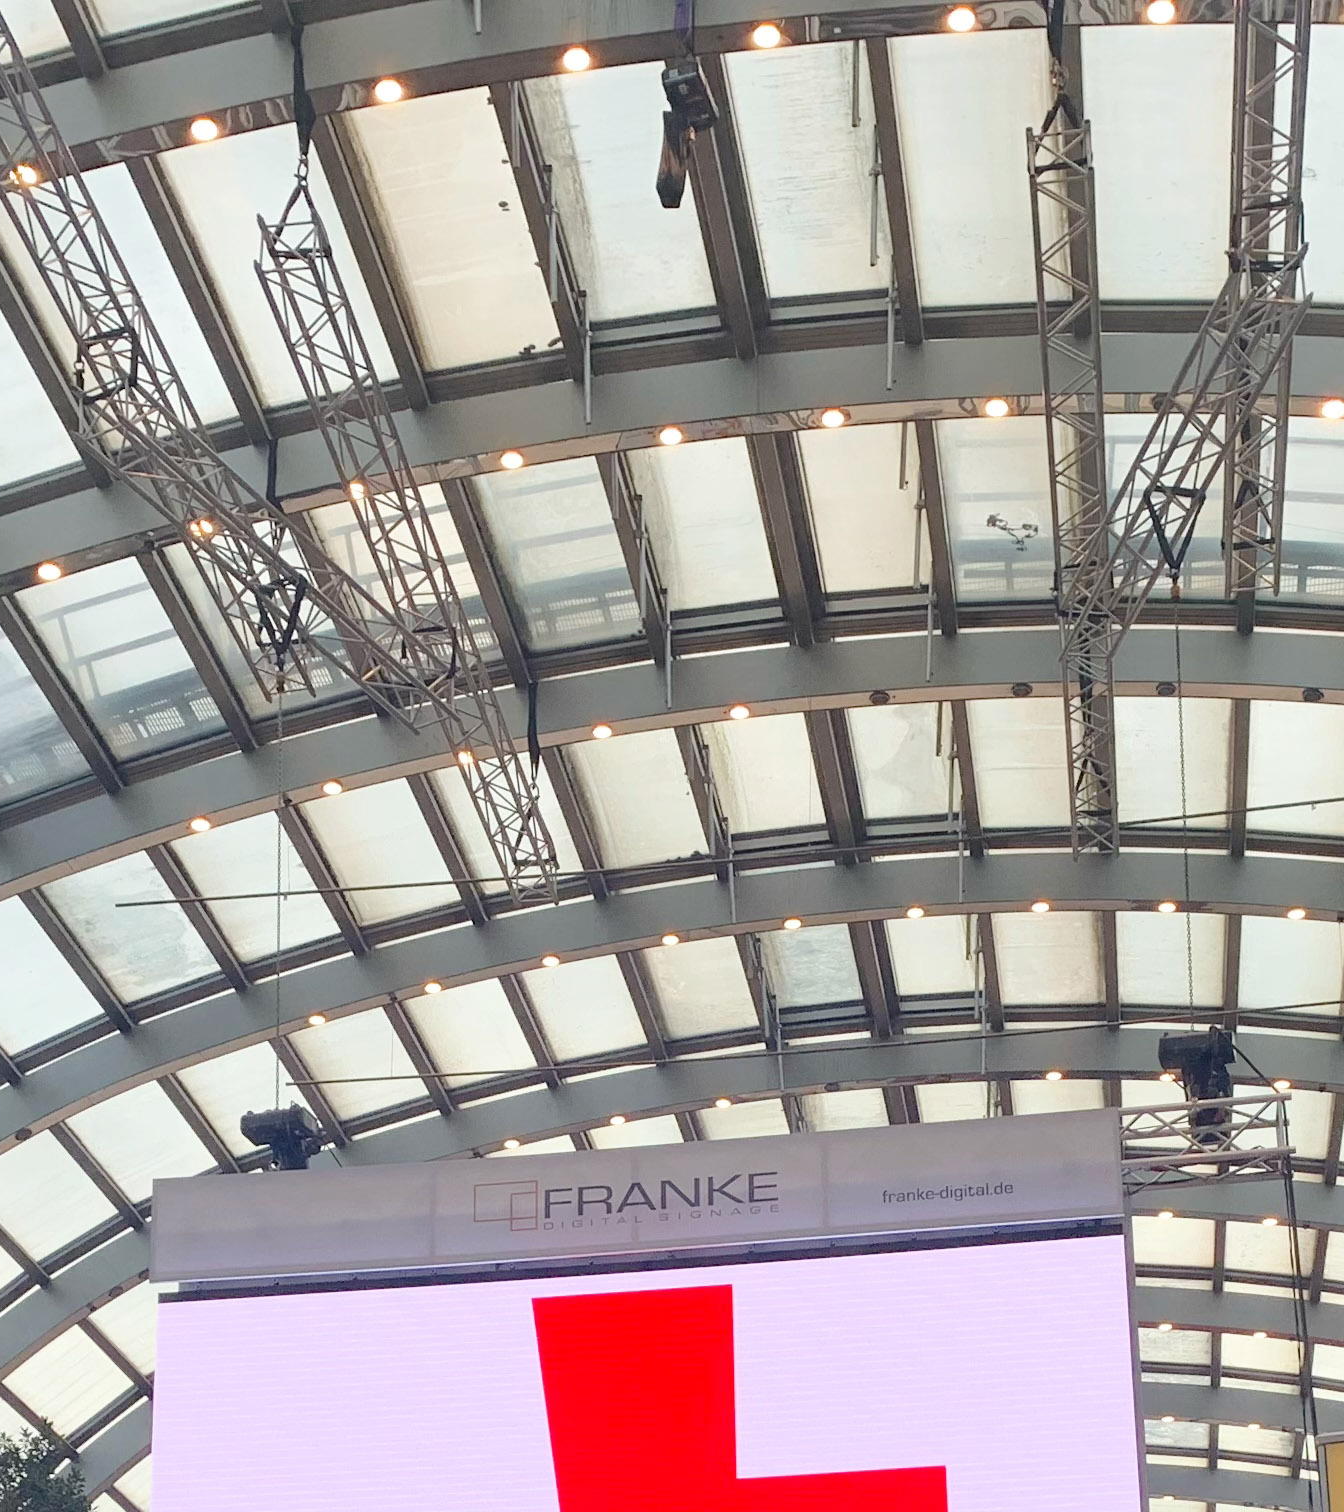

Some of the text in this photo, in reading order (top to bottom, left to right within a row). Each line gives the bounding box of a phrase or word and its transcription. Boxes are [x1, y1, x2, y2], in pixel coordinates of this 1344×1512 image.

[543, 1171, 780, 1219] FRANKE
[882, 1181, 1014, 1203] franke-digital.de
[543, 1203, 781, 1231] DIGITAL SIGNAGE
